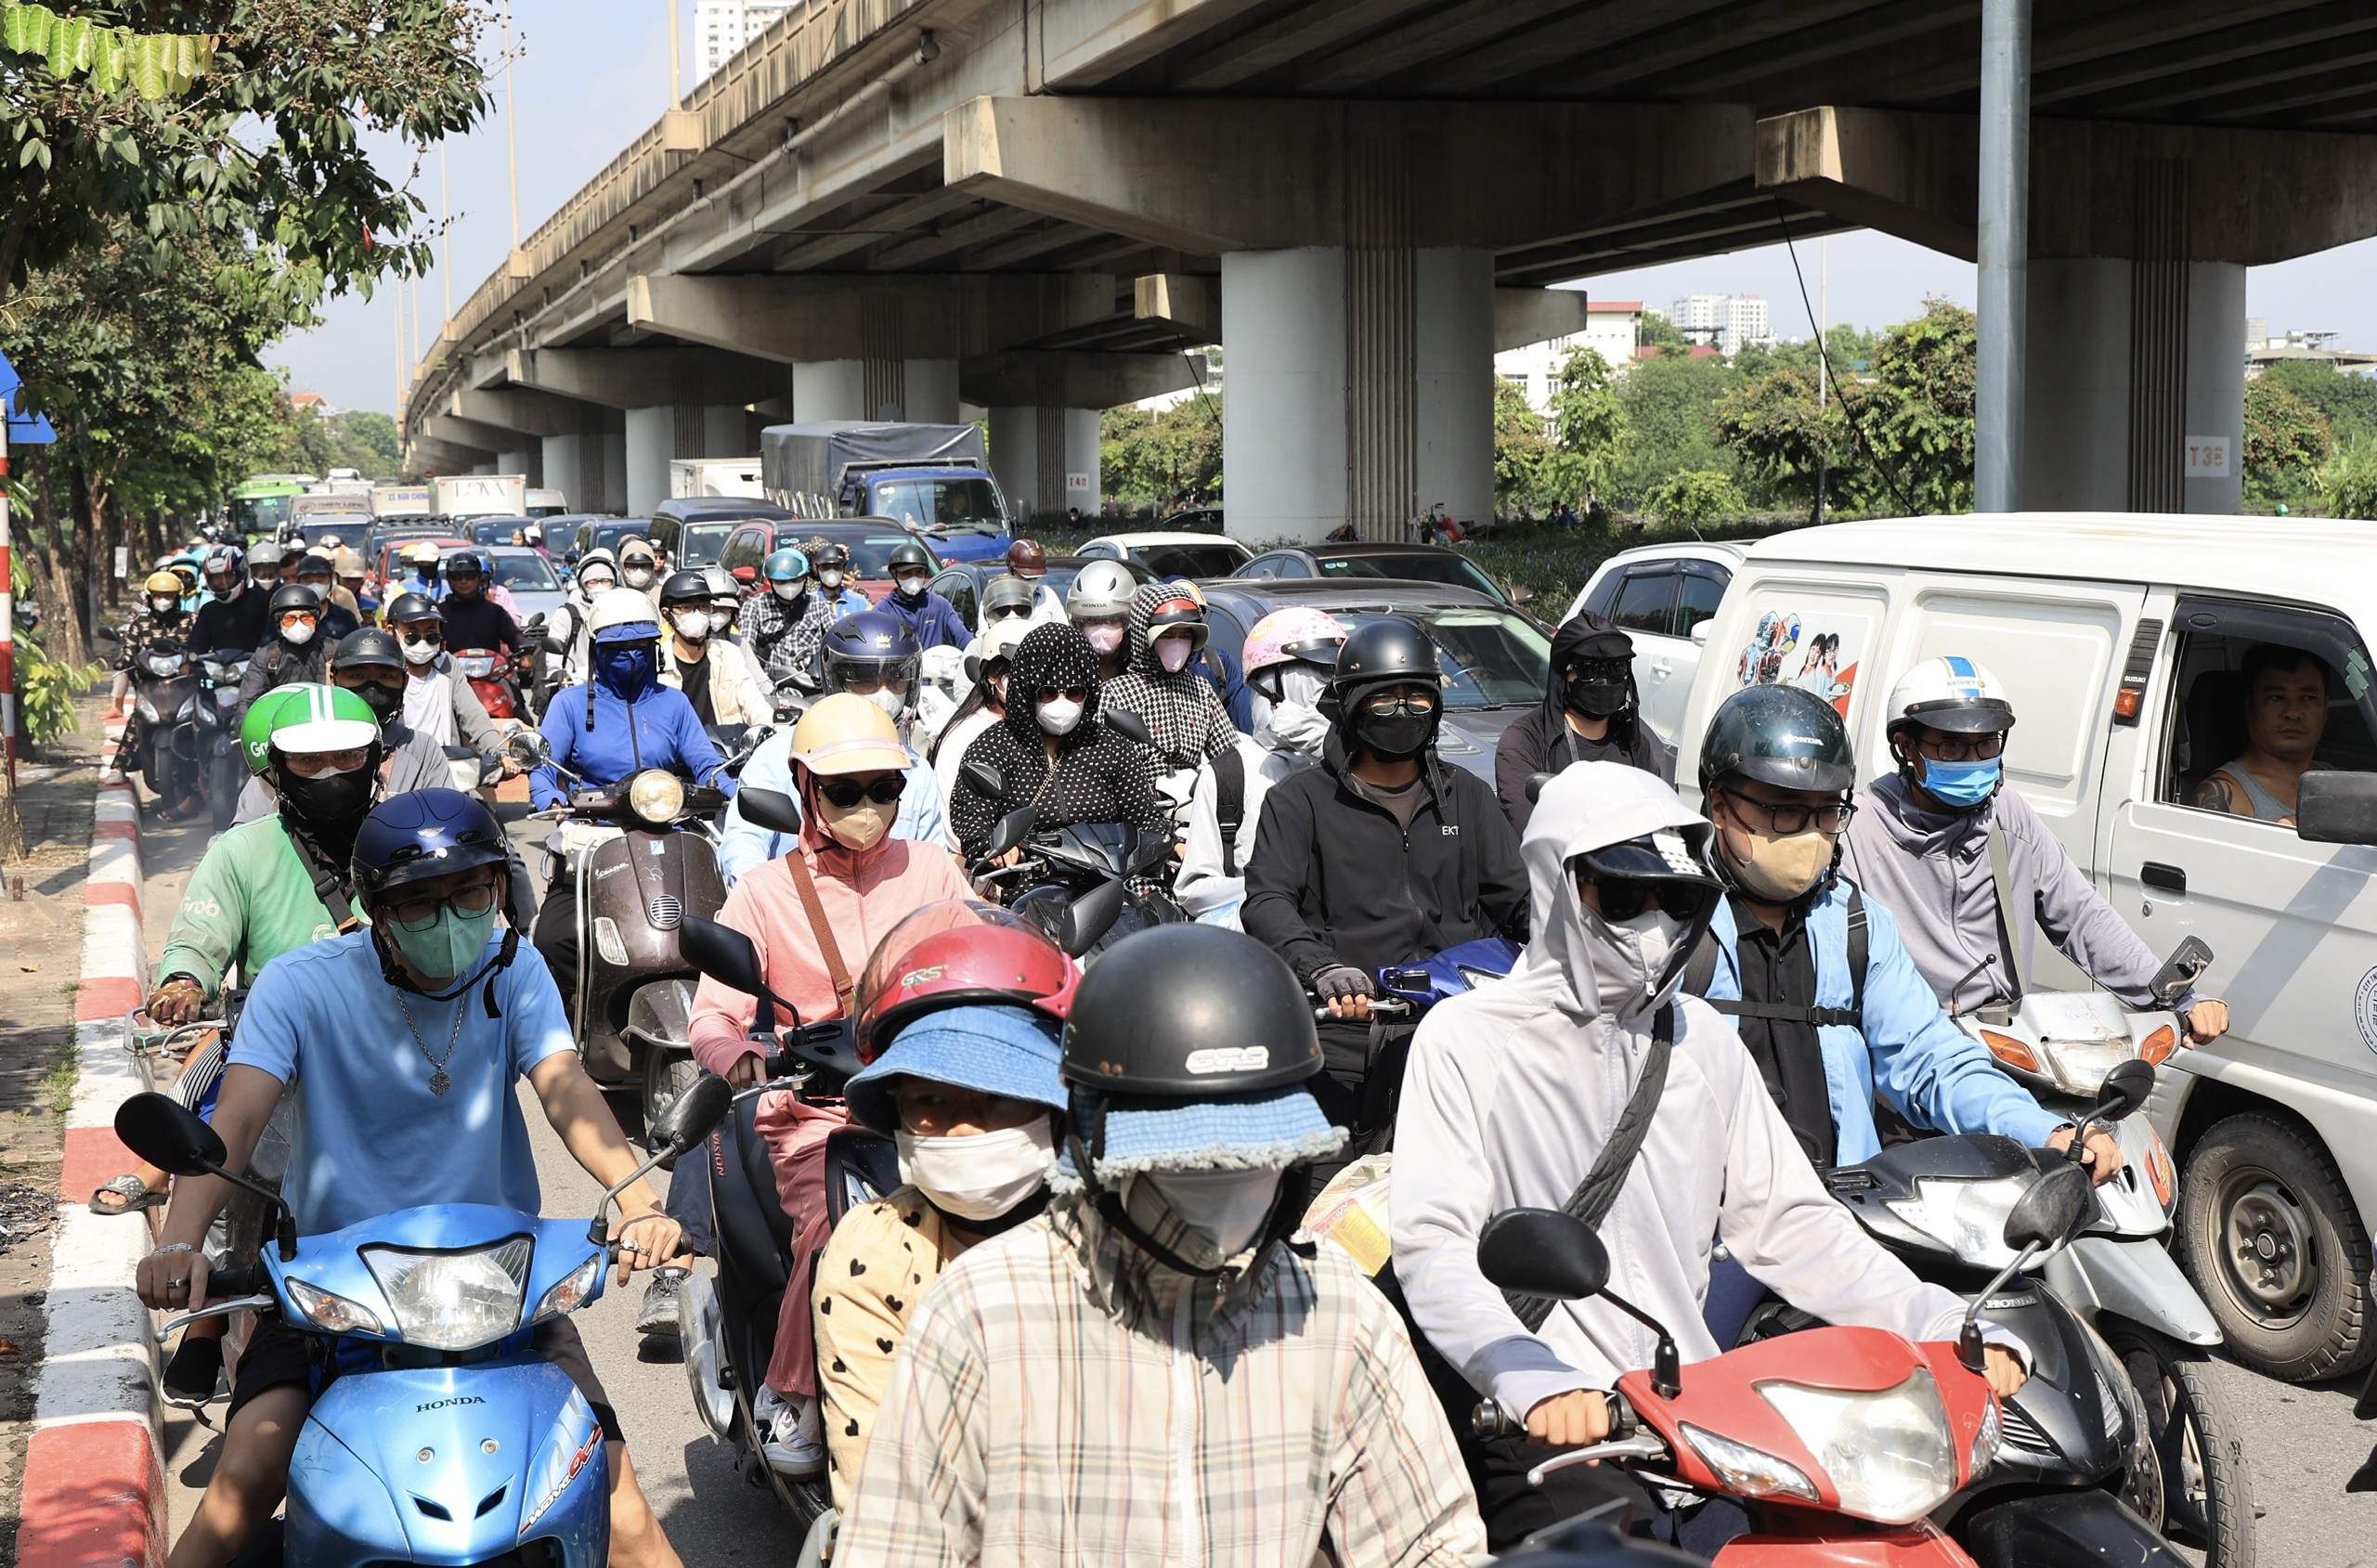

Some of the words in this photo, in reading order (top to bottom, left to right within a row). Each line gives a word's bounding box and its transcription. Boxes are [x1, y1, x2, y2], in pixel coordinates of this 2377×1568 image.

[2124, 675, 2146, 683] SUZUKI
[1442, 825, 1460, 836] EKT
[180, 896, 220, 917] Grab
[712, 1132, 726, 1176] VISION
[416, 1396, 487, 1413] HONDA
